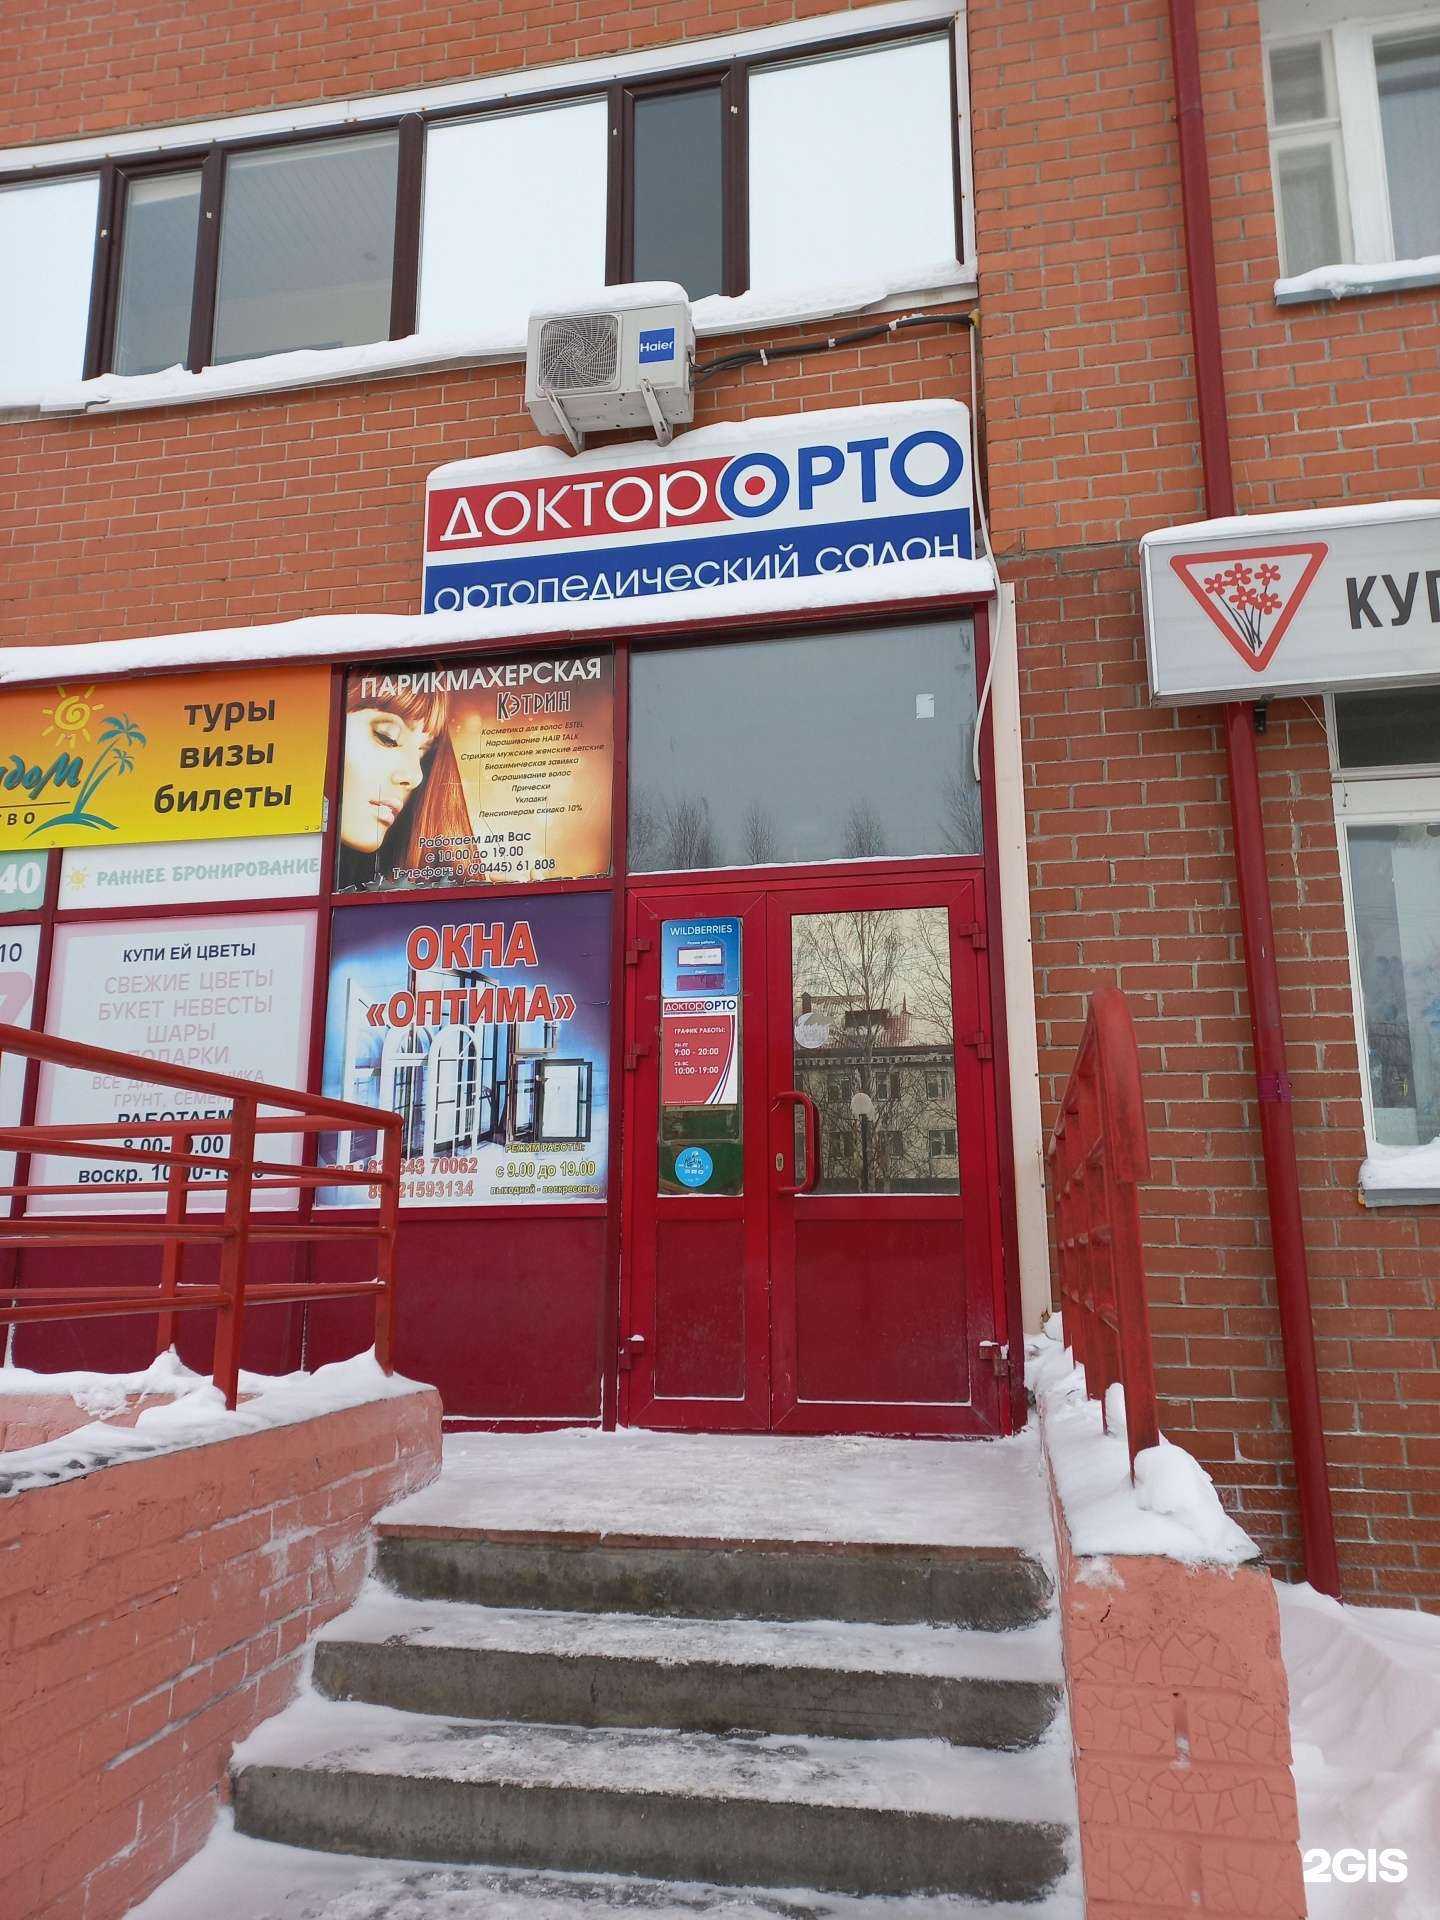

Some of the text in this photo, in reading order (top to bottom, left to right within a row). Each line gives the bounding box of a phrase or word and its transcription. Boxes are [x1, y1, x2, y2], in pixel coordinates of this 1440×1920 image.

[640, 340, 674, 353] Haier
[433, 532, 960, 614] ортопедический салон
[360, 657, 601, 699] ПАРИКМАХЕРСКАЯ
[184, 699, 276, 733] туры
[481, 726, 525, 736] Косметика
[540, 723, 563, 731] волос
[565, 721, 584, 729] ESTEL
[542, 735, 560, 743] HAIR
[562, 734, 580, 742] TALK
[180, 742, 275, 769] визы
[460, 744, 605, 761] Стрижки мужские женские детские
[484, 758, 580, 770] Биохимическая завивка
[491, 770, 572, 782] Окрашивание волос
[511, 784, 551, 793] Прически
[153, 784, 293, 814] билеты
[515, 796, 548, 804] Укладки
[536, 806, 567, 814] скидка
[568, 804, 583, 812] 10%
[418, 831, 532, 848] Работаем для Вас
[438, 849, 470, 863] 10.00
[473, 850, 488, 860] до
[492, 846, 524, 858] 19.00
[96, 858, 320, 887] РАННЕЕ БРОНИРОВАНИЕ
[468, 861, 512, 875] (90445)
[516, 860, 530, 871] 61
[534, 858, 556, 871] 808
[670, 924, 733, 936] WILDBERRIES
[122, 942, 256, 963] КУПИ ЕЙ ЦВЕТЫ
[406, 920, 538, 971] ОКНА
[104, 969, 274, 995] СВЕЖИЕ ЦВЕТЫ
[98, 995, 273, 1022] БУКЕТ НЕВЕСТЫ
[366, 984, 577, 1028] «ОПТИМА»
[146, 1022, 216, 1044] ШАРЫ
[674, 1048, 691, 1056] 9:00
[698, 1047, 719, 1056] 20:00
[92, 1076, 121, 1090] ВСЕ
[113, 1092, 166, 1108] ГРУНТ,
[504, 1143, 540, 1153] РЕЖИМ
[431, 1156, 478, 1175] 70062
[507, 1162, 535, 1177] 9.00
[537, 1164, 556, 1179] до
[560, 1160, 596, 1176] 19.00
[78, 1166, 143, 1184] воскр.
[490, 1184, 536, 1195] выходной
